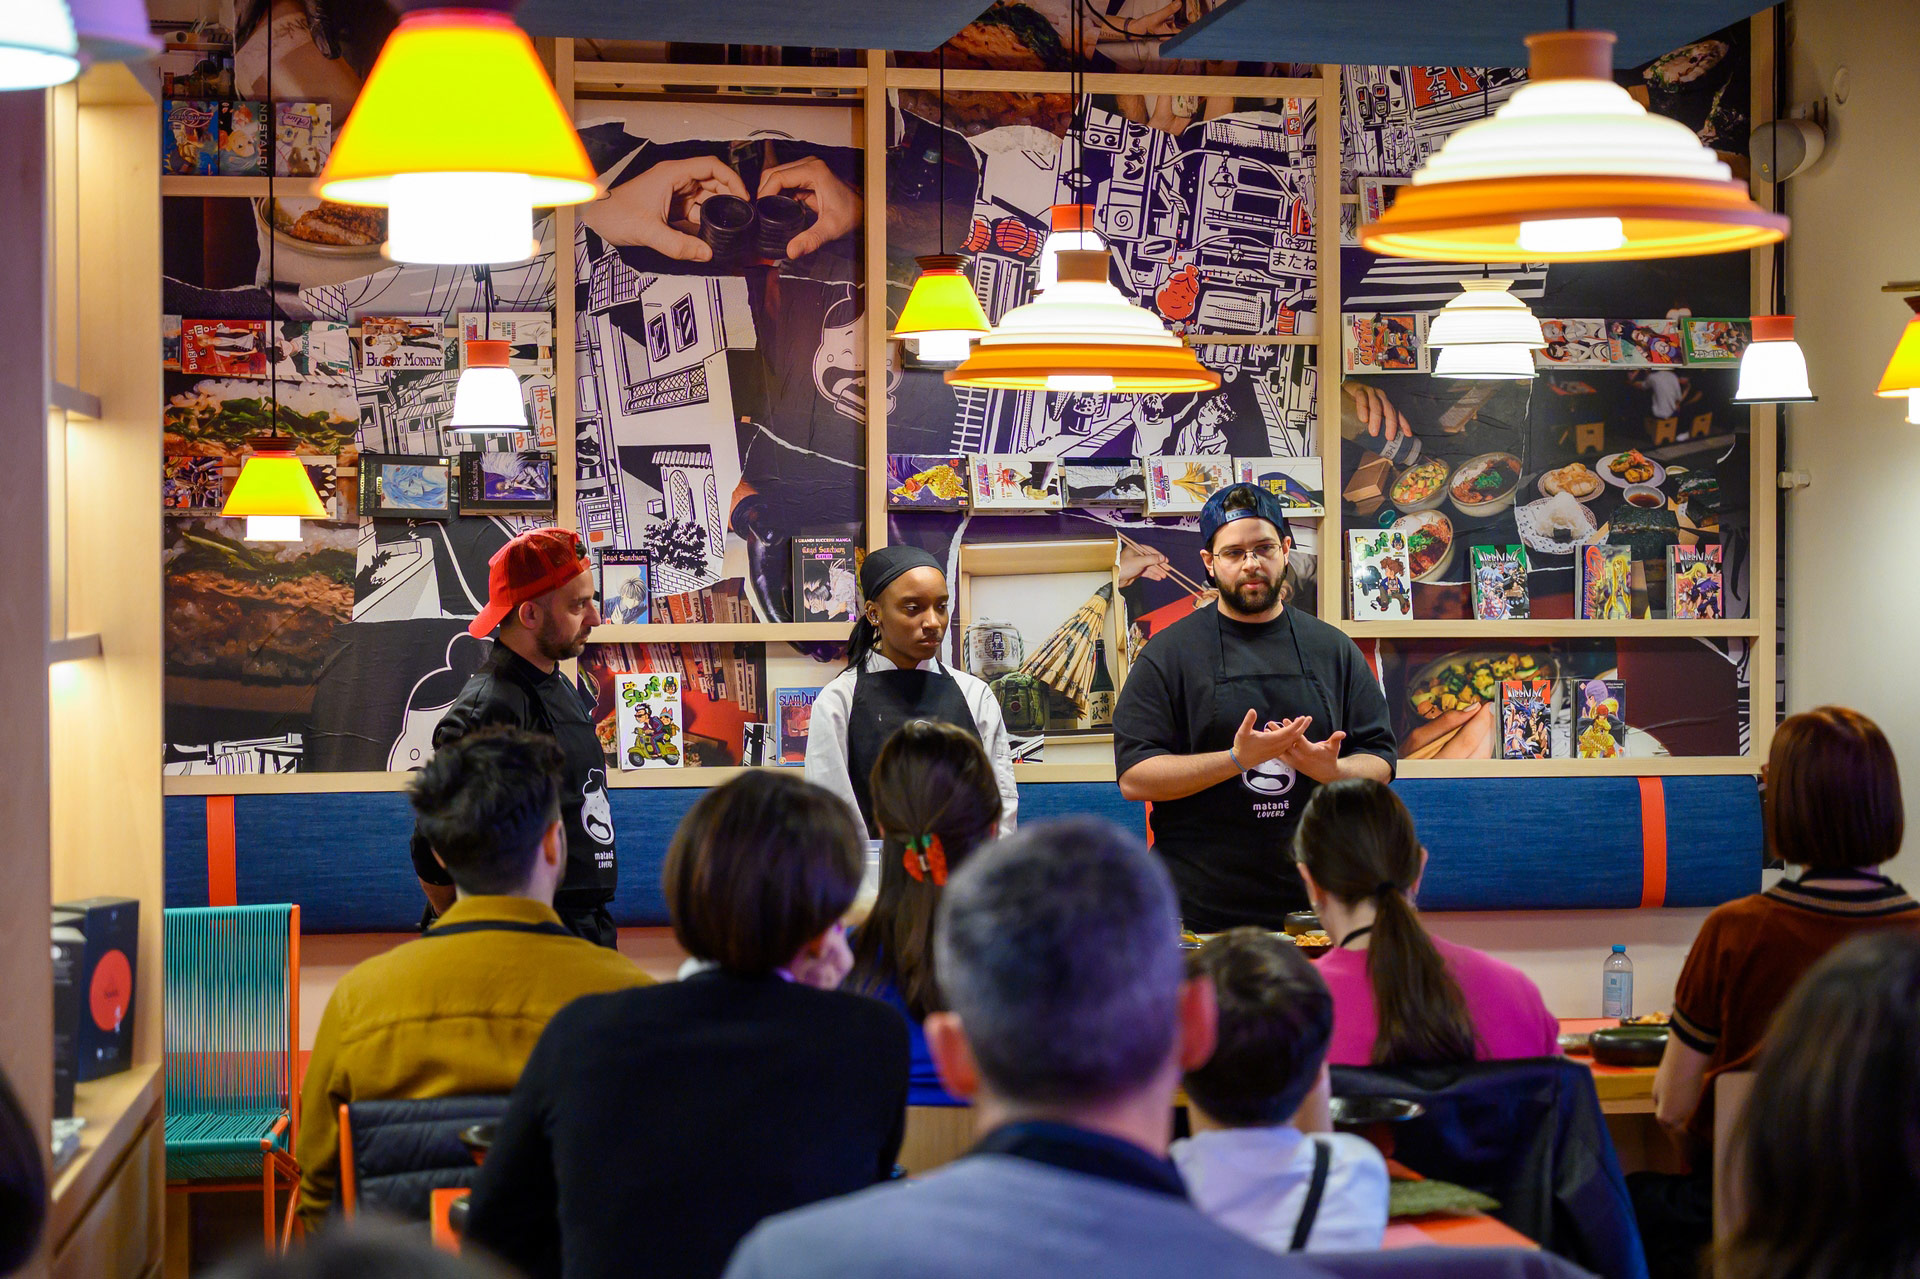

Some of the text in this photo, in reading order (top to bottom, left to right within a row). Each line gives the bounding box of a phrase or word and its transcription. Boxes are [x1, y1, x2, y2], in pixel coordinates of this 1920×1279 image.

[258, 104, 268, 177] NOSTALGIA
[1272, 251, 1317, 270] またね
[492, 321, 501, 330] 12
[1358, 318, 1374, 366] NARUTO
[186, 343, 198, 370] Bugie
[404, 353, 443, 368] MONDAY
[534, 387, 555, 437] またね
[779, 693, 800, 707] SLAM
[1257, 810, 1285, 818] LOVERS
